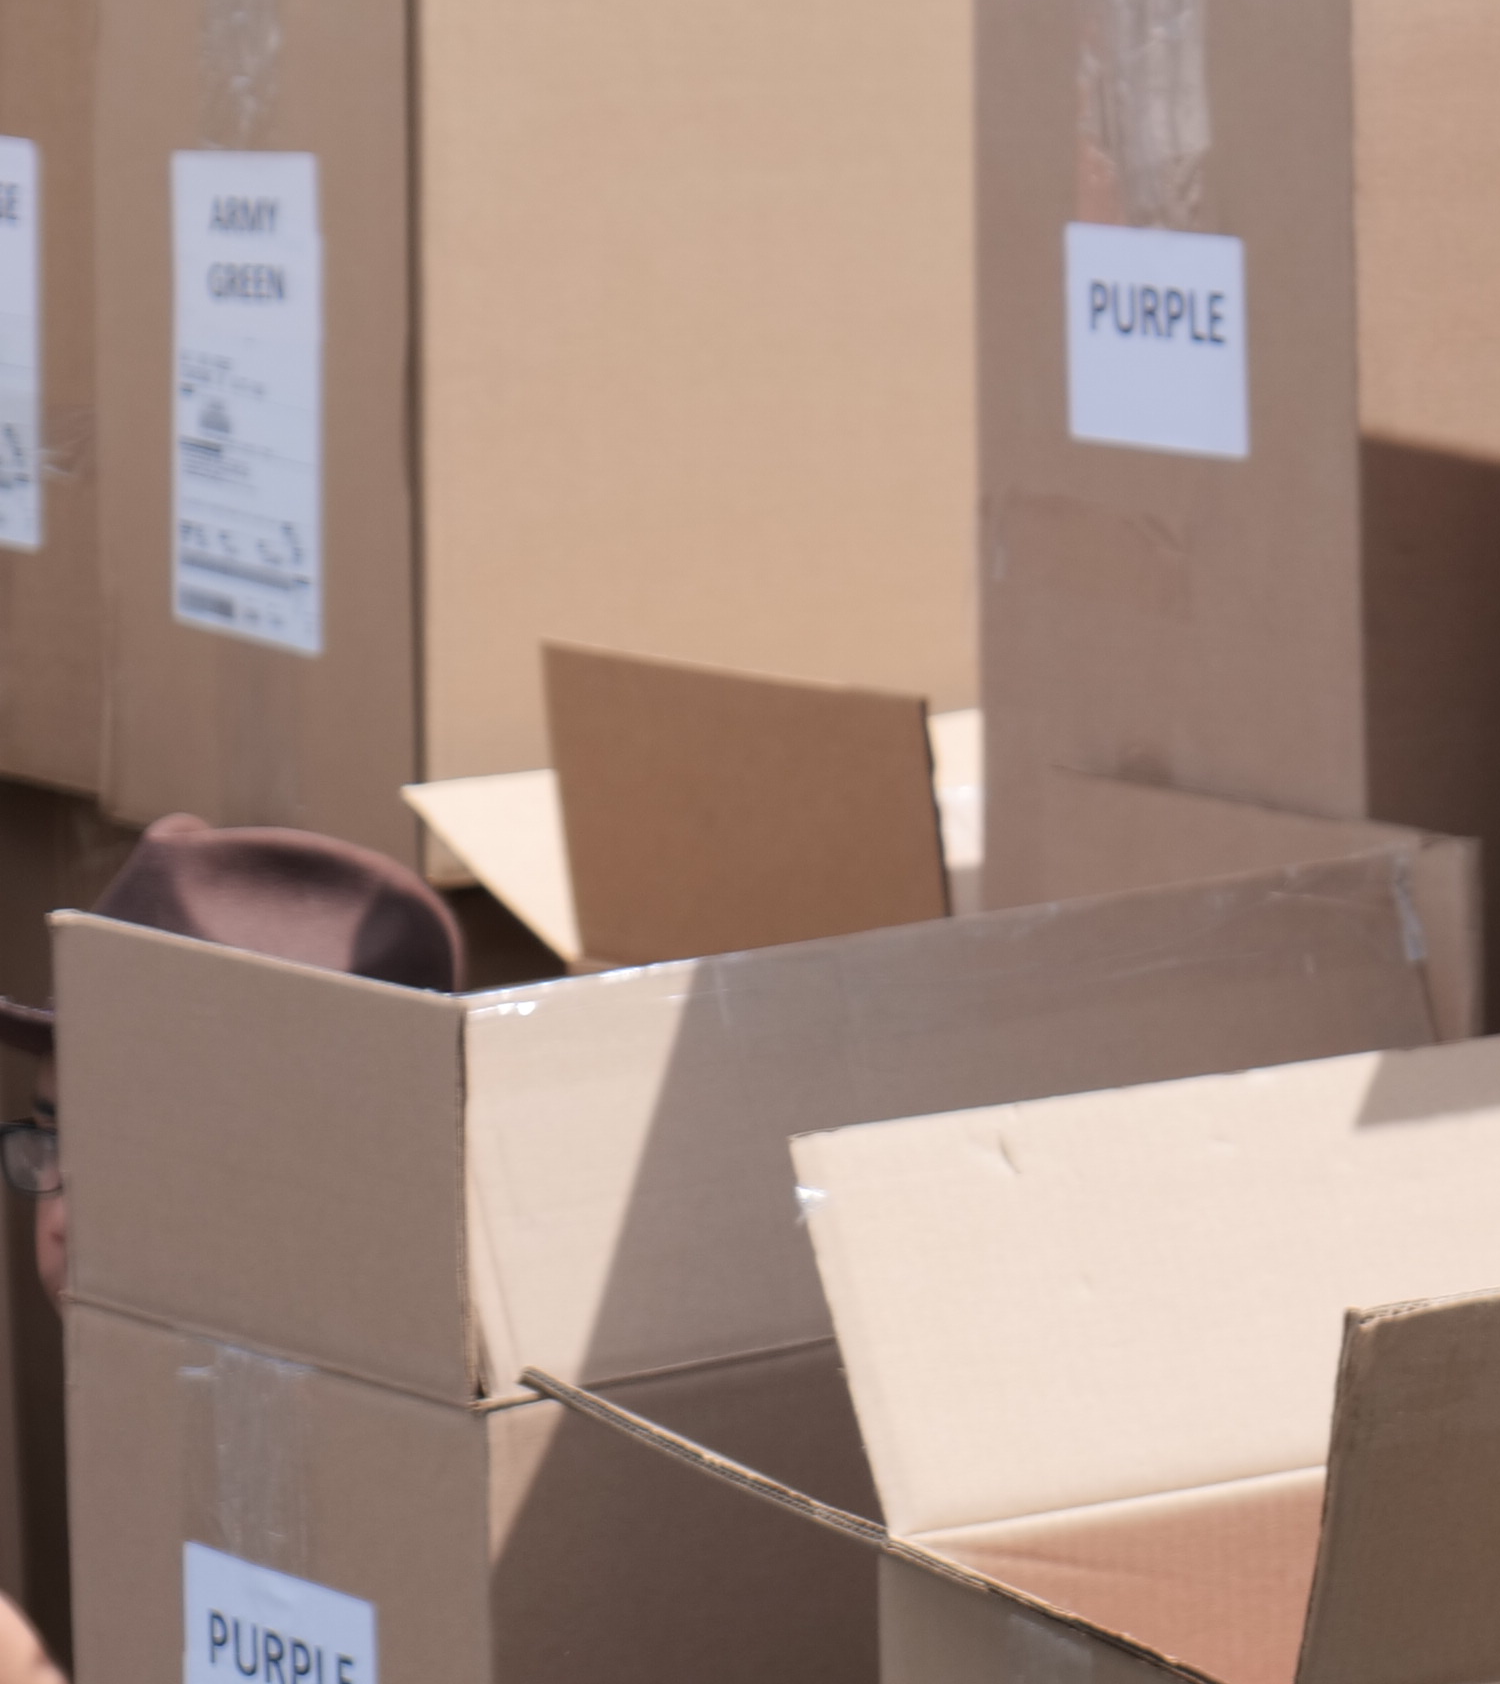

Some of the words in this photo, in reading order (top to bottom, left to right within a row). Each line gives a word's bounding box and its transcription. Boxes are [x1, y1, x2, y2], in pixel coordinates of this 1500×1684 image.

[208, 196, 278, 233] ARMY
[206, 262, 286, 302] GREEN
[1090, 280, 1225, 344] PURPLE
